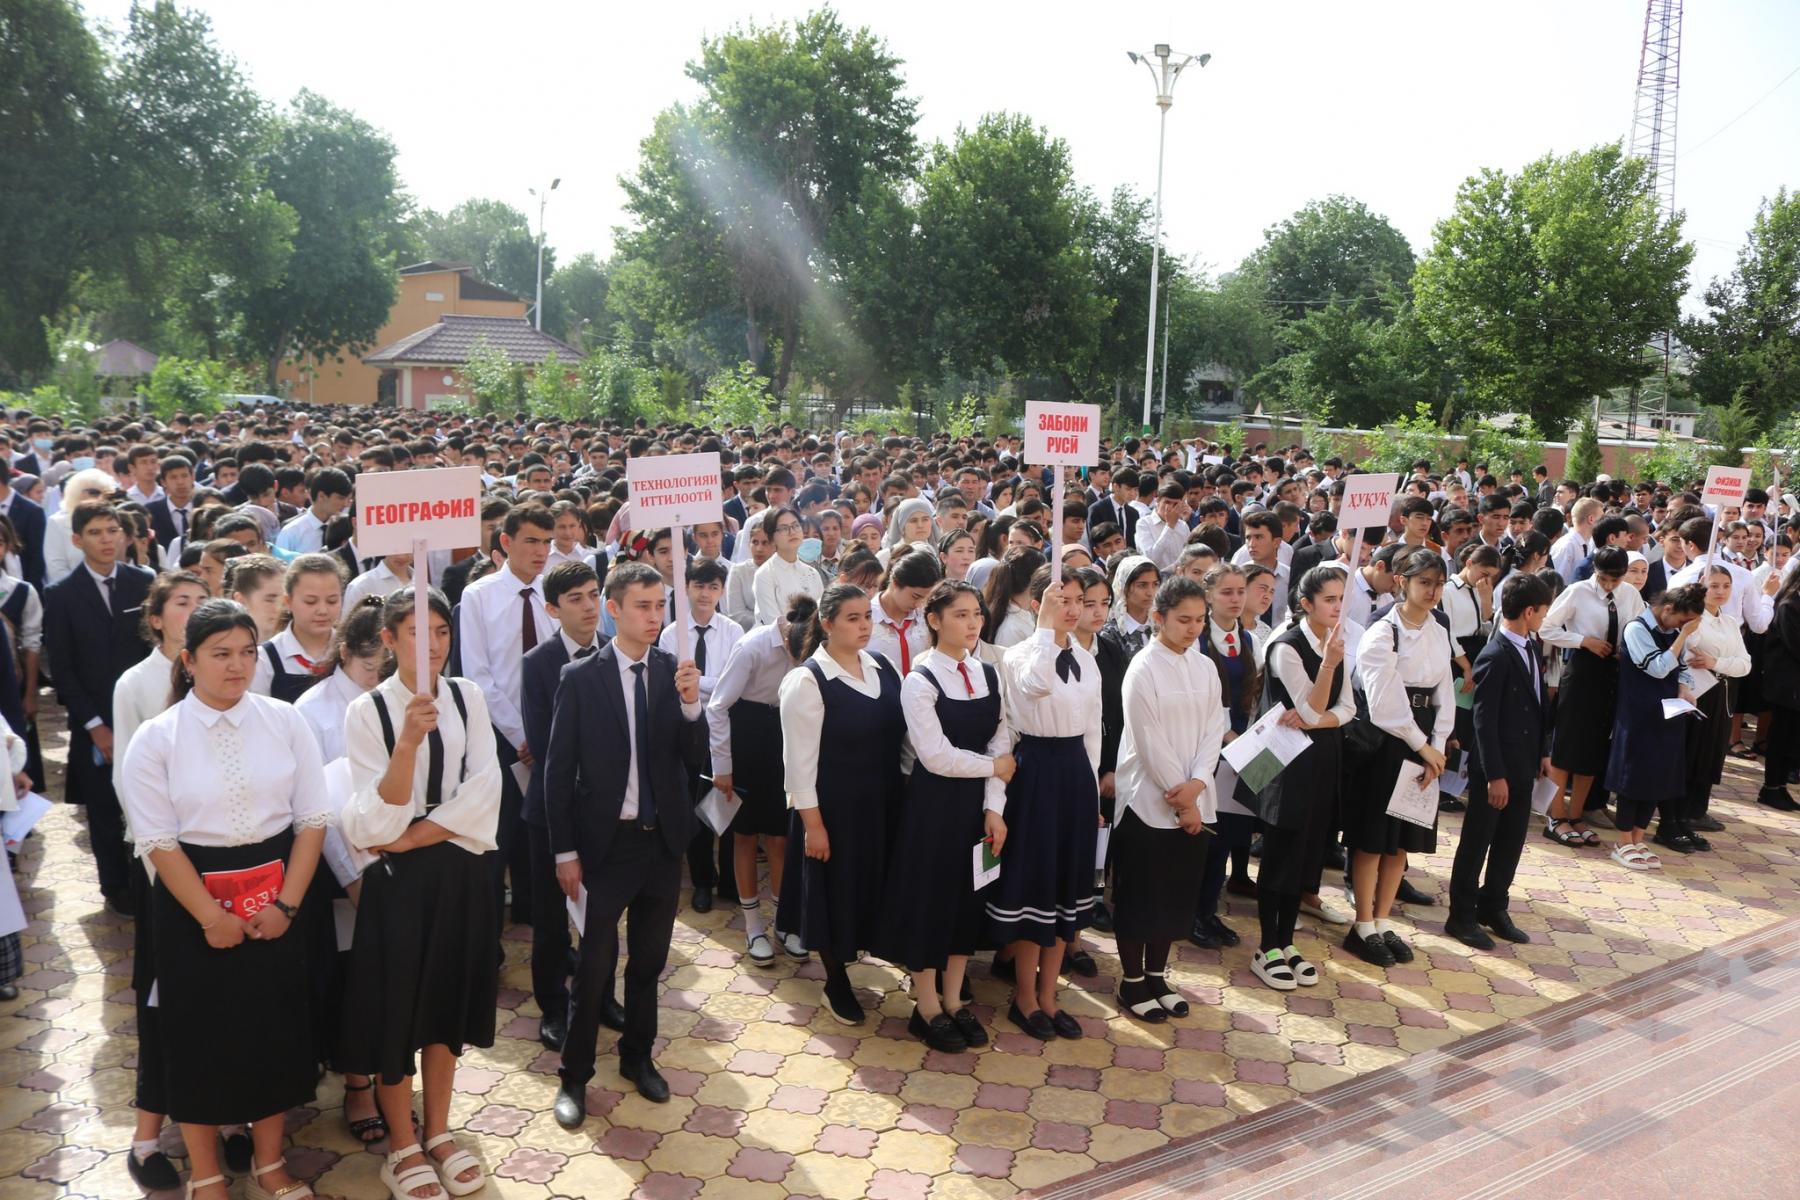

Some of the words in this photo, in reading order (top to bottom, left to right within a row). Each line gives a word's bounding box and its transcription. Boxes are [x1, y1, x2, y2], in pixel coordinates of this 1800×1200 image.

[1038, 413, 1088, 432] ЗАБОНИ
[1047, 434, 1079, 454] РУСӢ
[632, 474, 718, 492] ТЕХНОЛОГИЯИ
[365, 498, 475, 526] ГЕОГРАФИЯ
